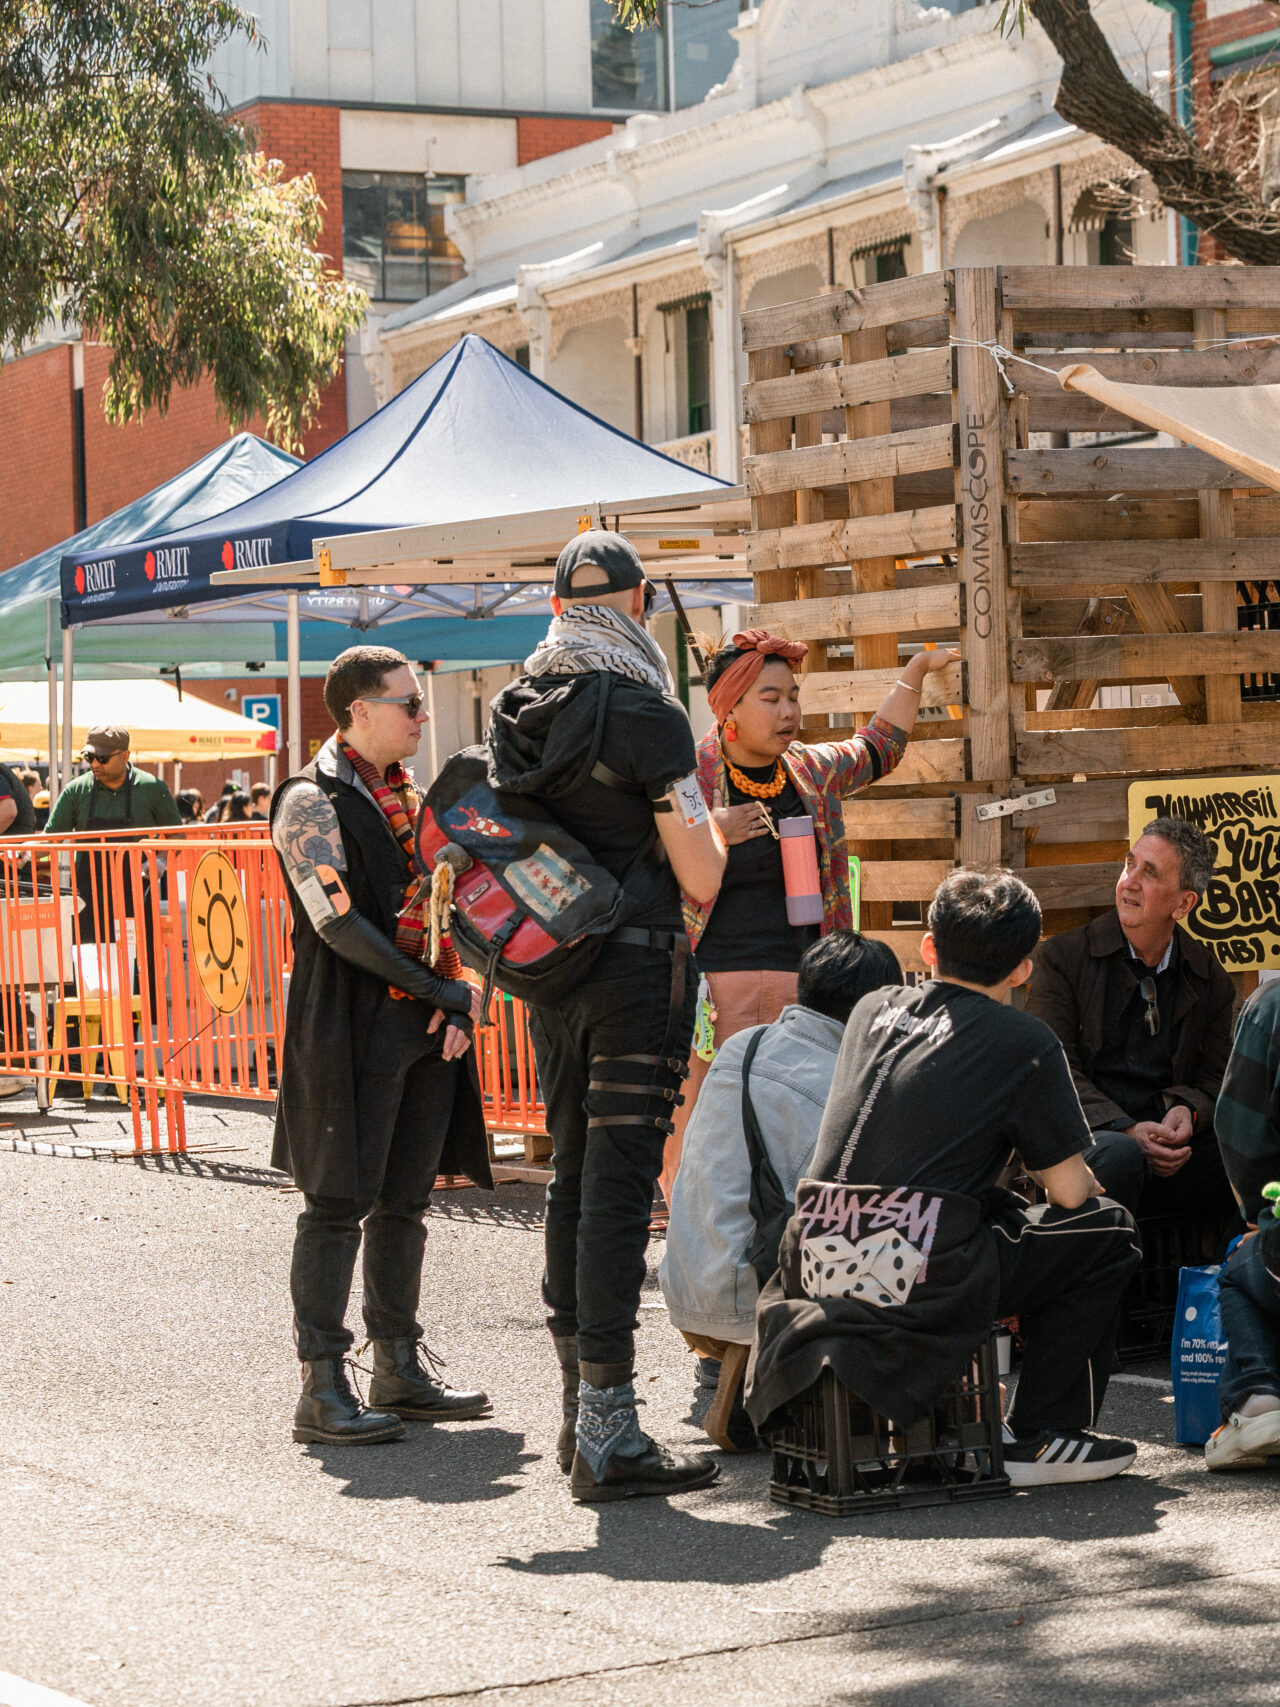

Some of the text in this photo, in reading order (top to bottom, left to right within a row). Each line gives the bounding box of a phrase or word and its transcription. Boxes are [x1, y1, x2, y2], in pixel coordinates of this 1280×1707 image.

[966, 413, 992, 639] COMMSCOPE
[156, 546, 190, 579] RMIT
[234, 538, 272, 569] RMIT
[85, 559, 117, 593] RMIT
[251, 703, 270, 720] P
[1181, 1338, 1191, 1348] I'm
[1192, 1338, 1206, 1349] 70%
[1181, 1353, 1194, 1363] and
[1195, 1353, 1214, 1363] 100%
